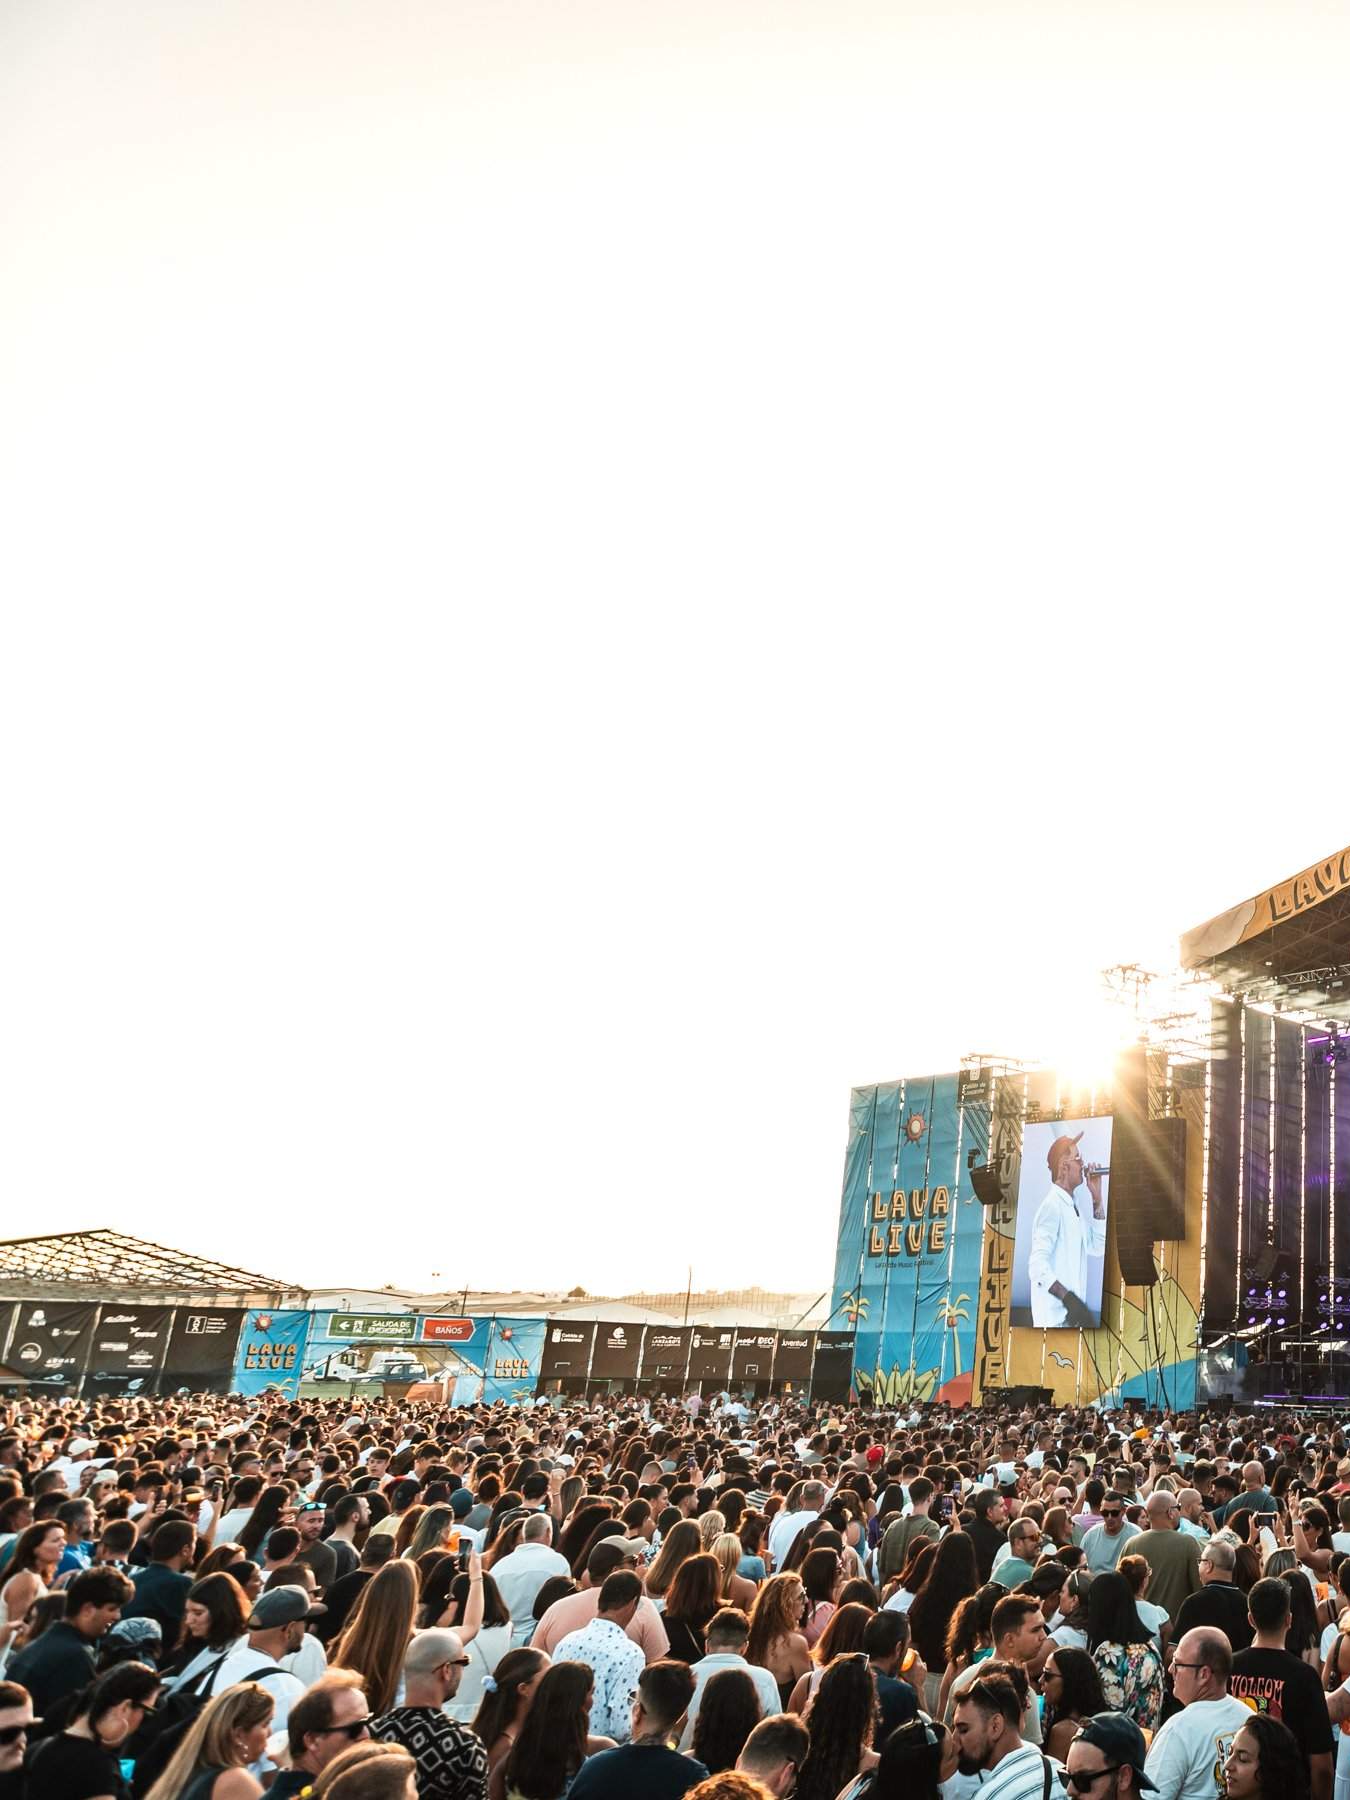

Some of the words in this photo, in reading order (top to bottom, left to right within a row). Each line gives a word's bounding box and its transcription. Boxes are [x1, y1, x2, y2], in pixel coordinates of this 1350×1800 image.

[871, 1185, 950, 1223] LAVA
[868, 1221, 948, 1257] LIVE
[979, 1238, 1010, 1392] LIVE
[371, 1320, 399, 1328] SALIDA
[435, 1325, 463, 1335] BAÑOS
[247, 1343, 297, 1355] LAVA
[244, 1356, 295, 1370] LIVE
[495, 1359, 529, 1369] LAVA
[494, 1368, 529, 1379] LIVE
[1231, 1674, 1286, 1709] VOLCOM
